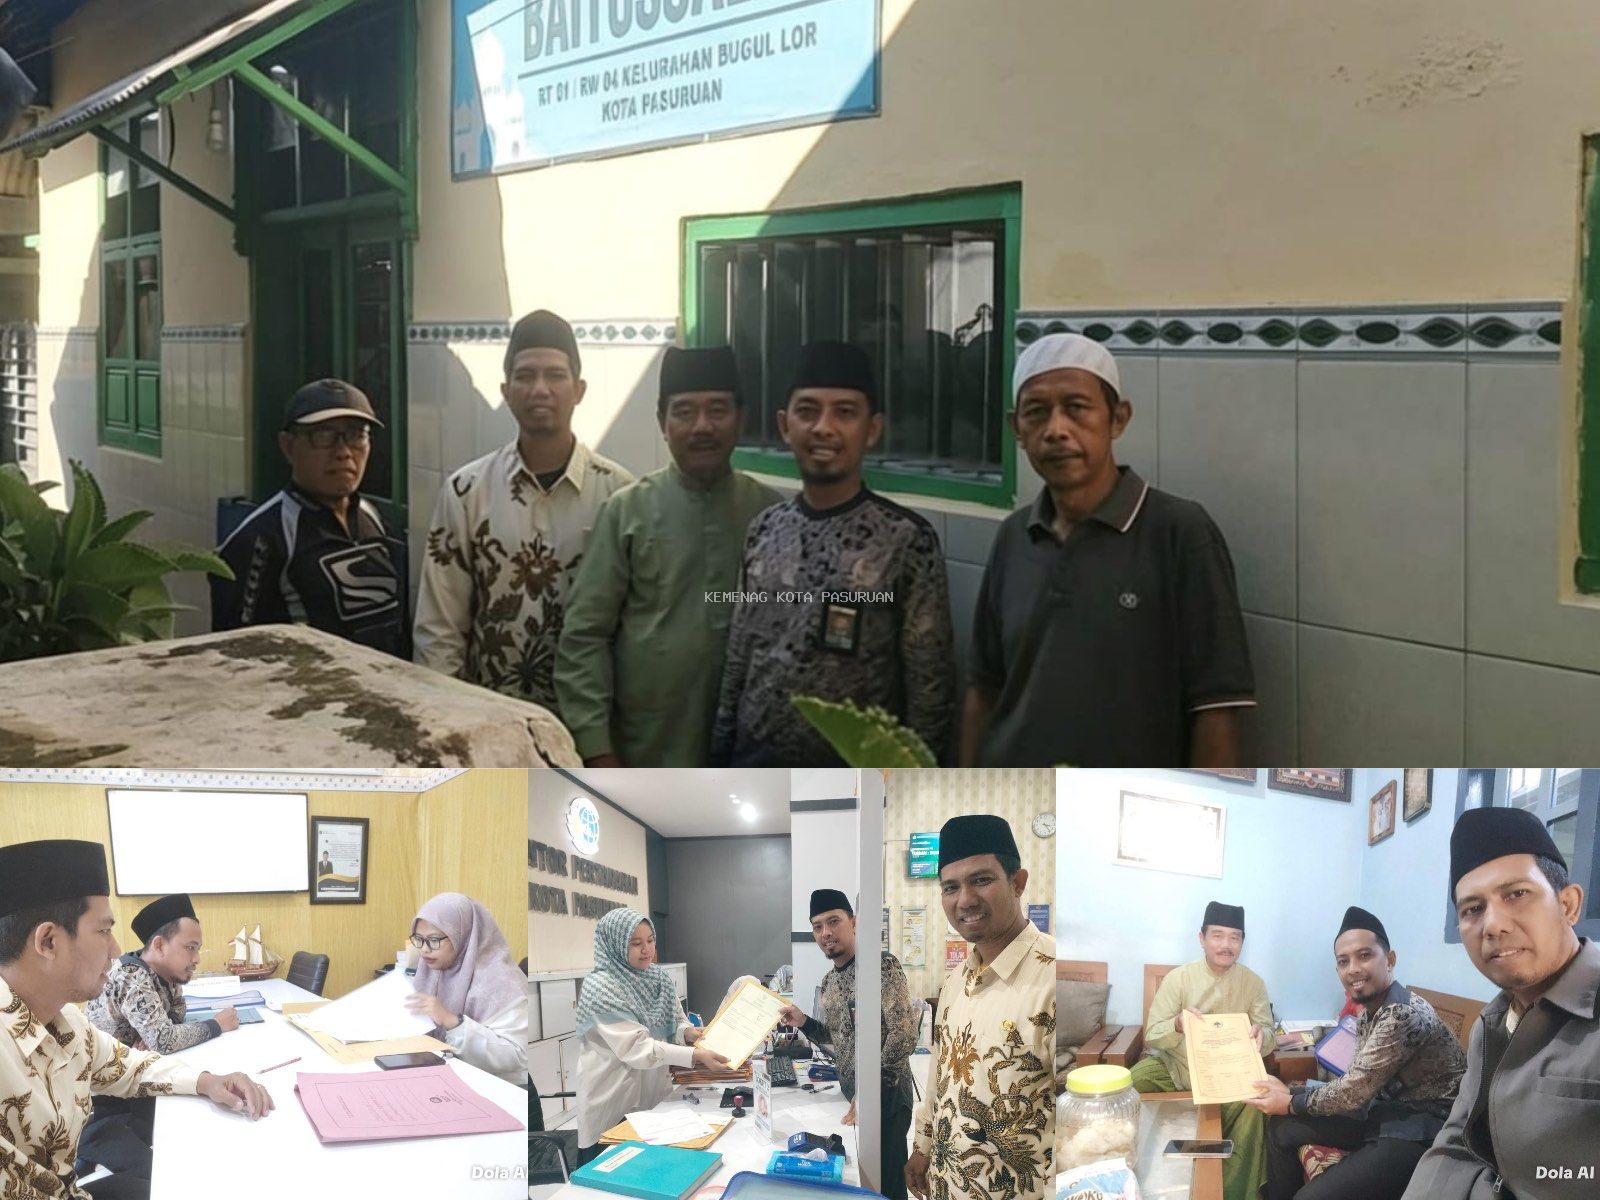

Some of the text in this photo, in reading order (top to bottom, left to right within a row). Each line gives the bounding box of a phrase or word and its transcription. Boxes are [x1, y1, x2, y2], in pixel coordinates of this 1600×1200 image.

[523, 0, 751, 62] BAITU
[538, 85, 553, 107] RT
[556, 81, 569, 103] 01
[580, 74, 600, 97] RW
[603, 67, 618, 92] 04
[621, 46, 712, 87] KELURAHAN
[718, 31, 775, 67] BUGUL
[781, 21, 817, 53] LOR
[601, 78, 722, 122] KOTA PASURUAN
